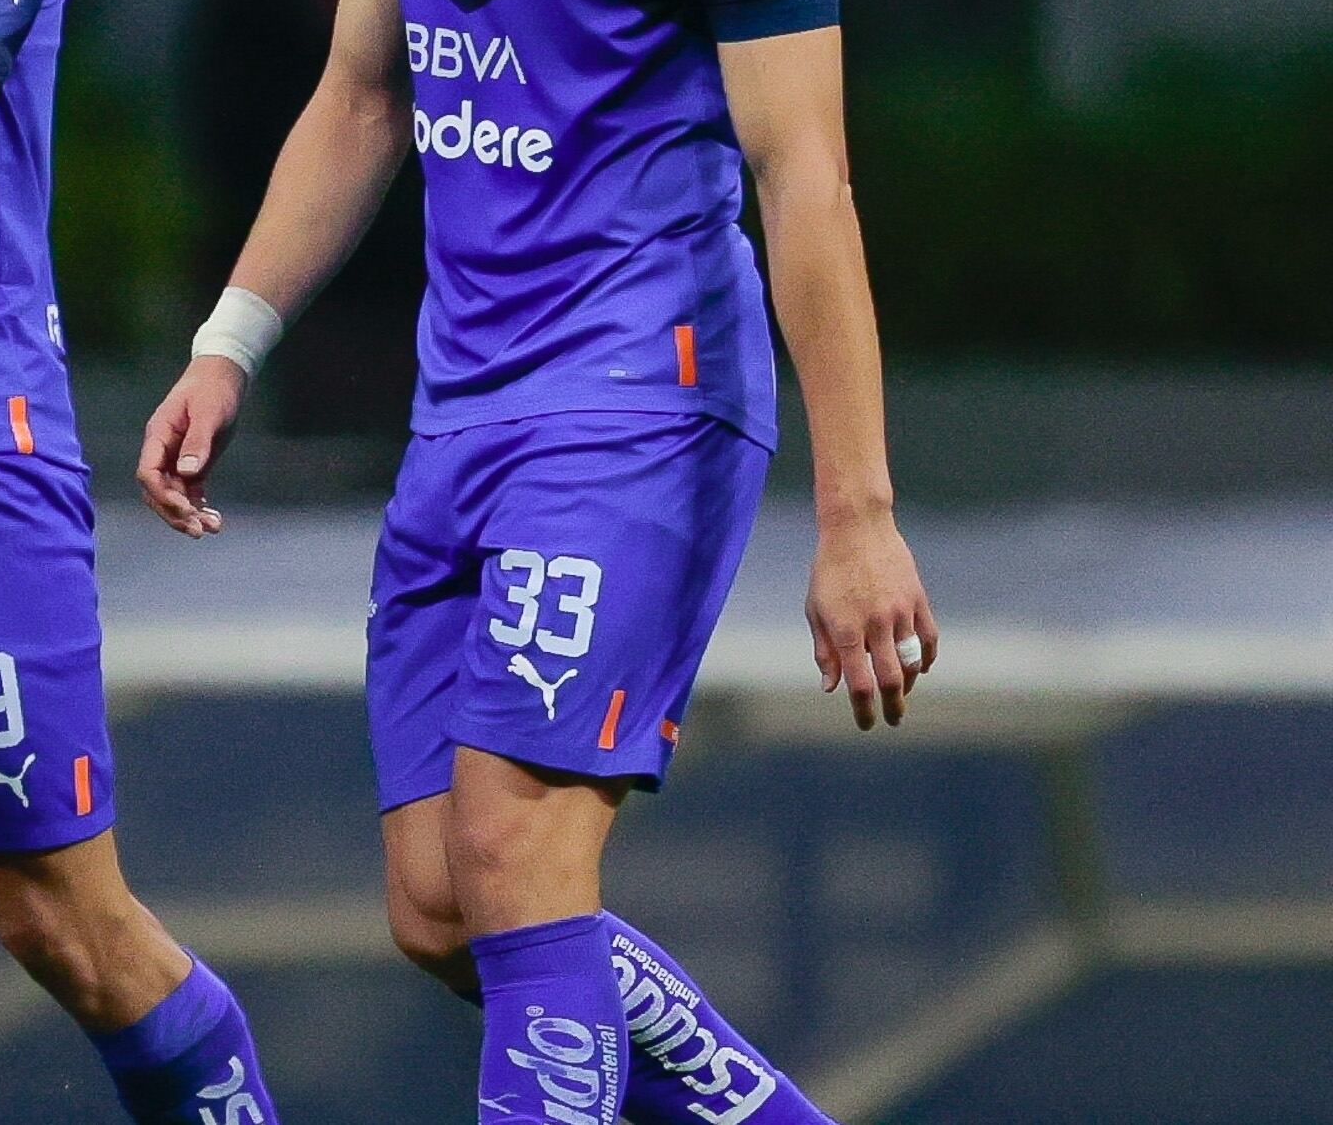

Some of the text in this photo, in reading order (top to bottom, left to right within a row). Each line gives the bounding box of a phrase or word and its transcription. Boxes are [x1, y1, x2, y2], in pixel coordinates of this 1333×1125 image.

[406, 22, 527, 85] BBVA
[413, 100, 554, 173] odere
[489, 548, 603, 658] 33
[612, 933, 701, 1010] Antibacterial
